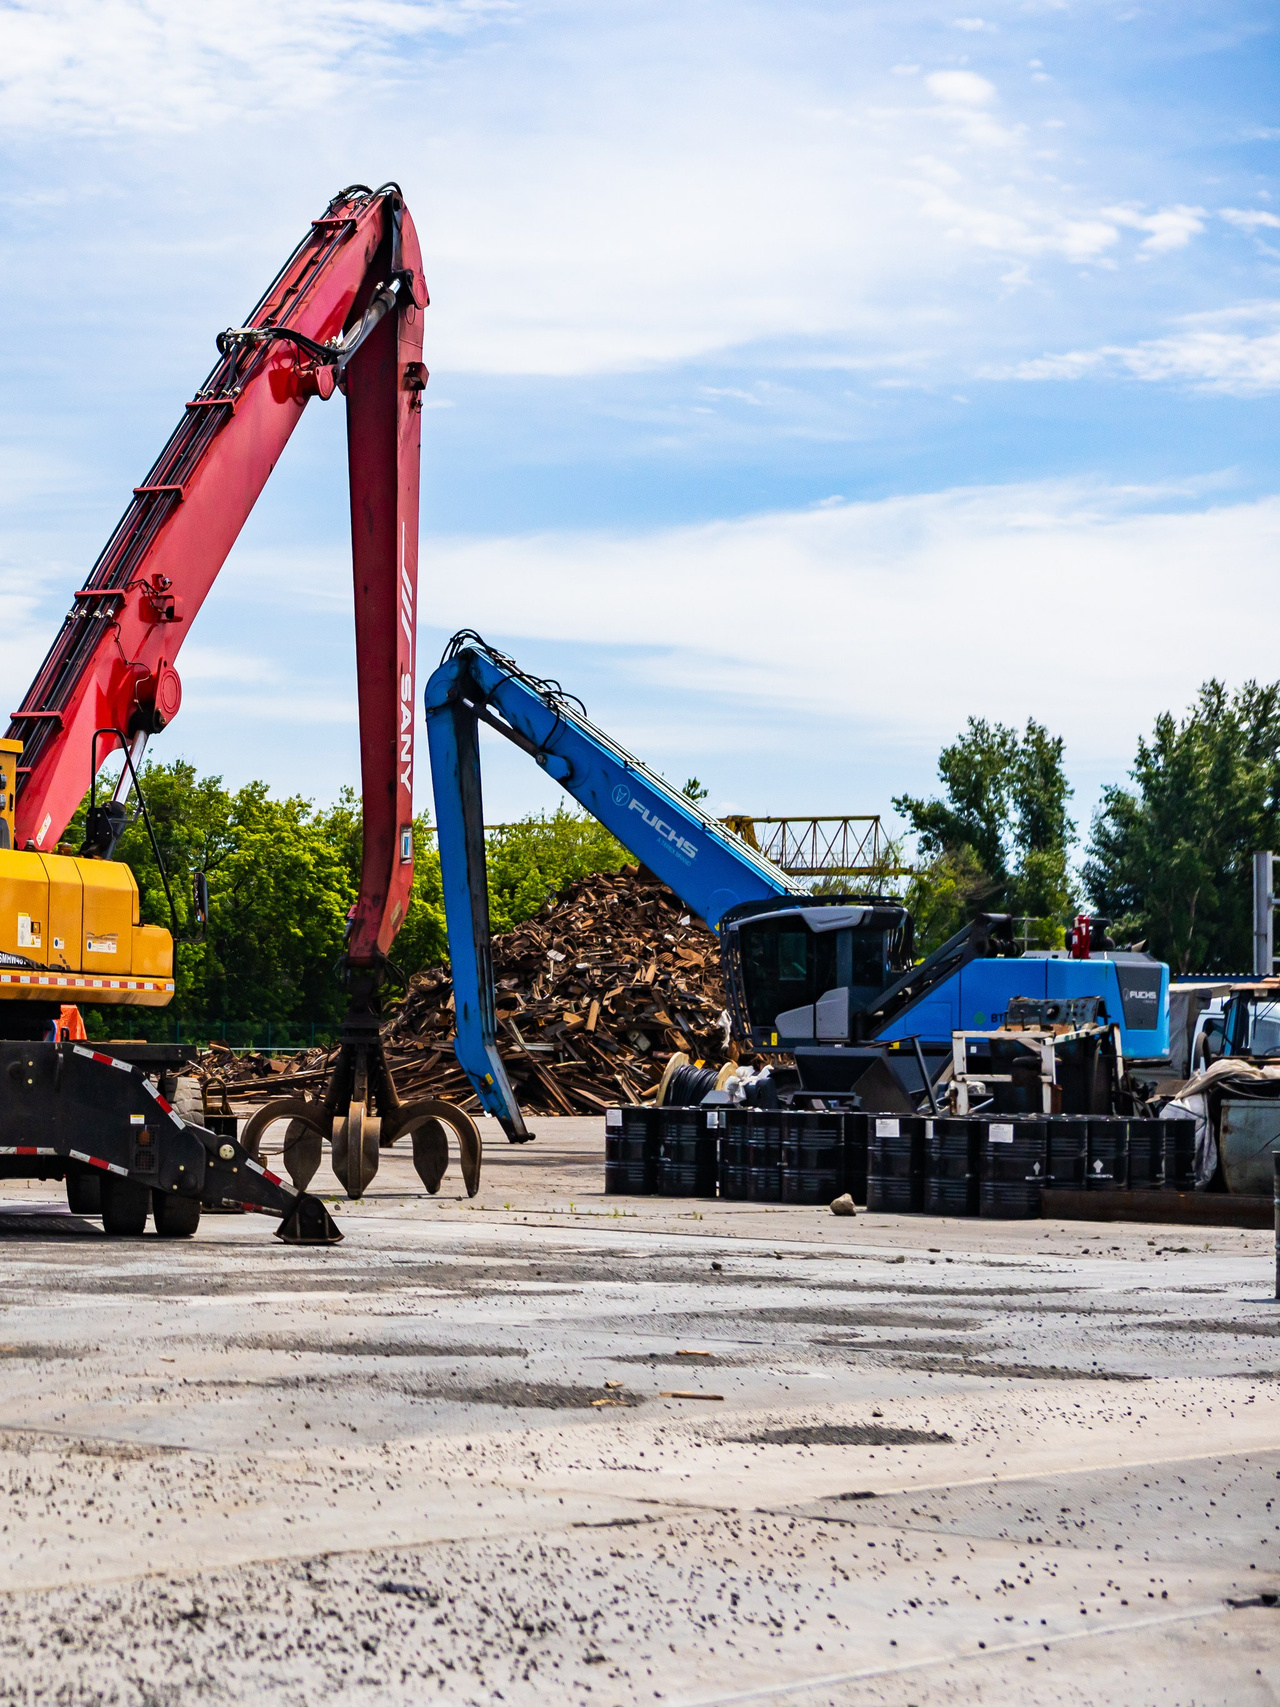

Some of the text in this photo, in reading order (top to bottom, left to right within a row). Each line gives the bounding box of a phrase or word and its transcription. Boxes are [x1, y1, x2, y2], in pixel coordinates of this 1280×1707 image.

[401, 673, 412, 794] SANY
[628, 798, 698, 859] FUCHS
[1130, 991, 1157, 999] FUCHS
